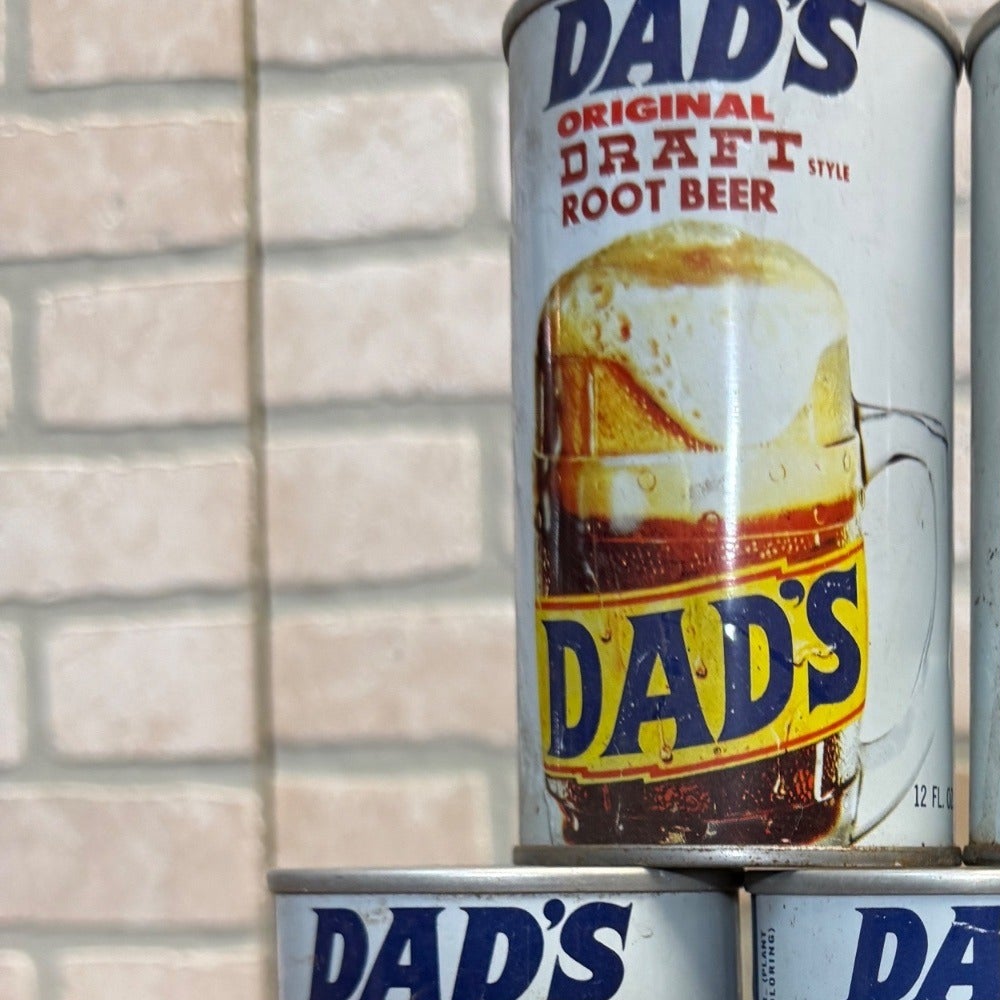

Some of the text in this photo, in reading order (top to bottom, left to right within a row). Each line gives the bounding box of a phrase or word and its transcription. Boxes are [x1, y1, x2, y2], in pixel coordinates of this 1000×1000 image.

[556, 92, 774, 138] ORIGINAL
[560, 128, 850, 186] DRAFT STYLE
[562, 177, 778, 228] ROOT BEER
[541, 565, 861, 758] DAD'S
[914, 784, 927, 808] 12
